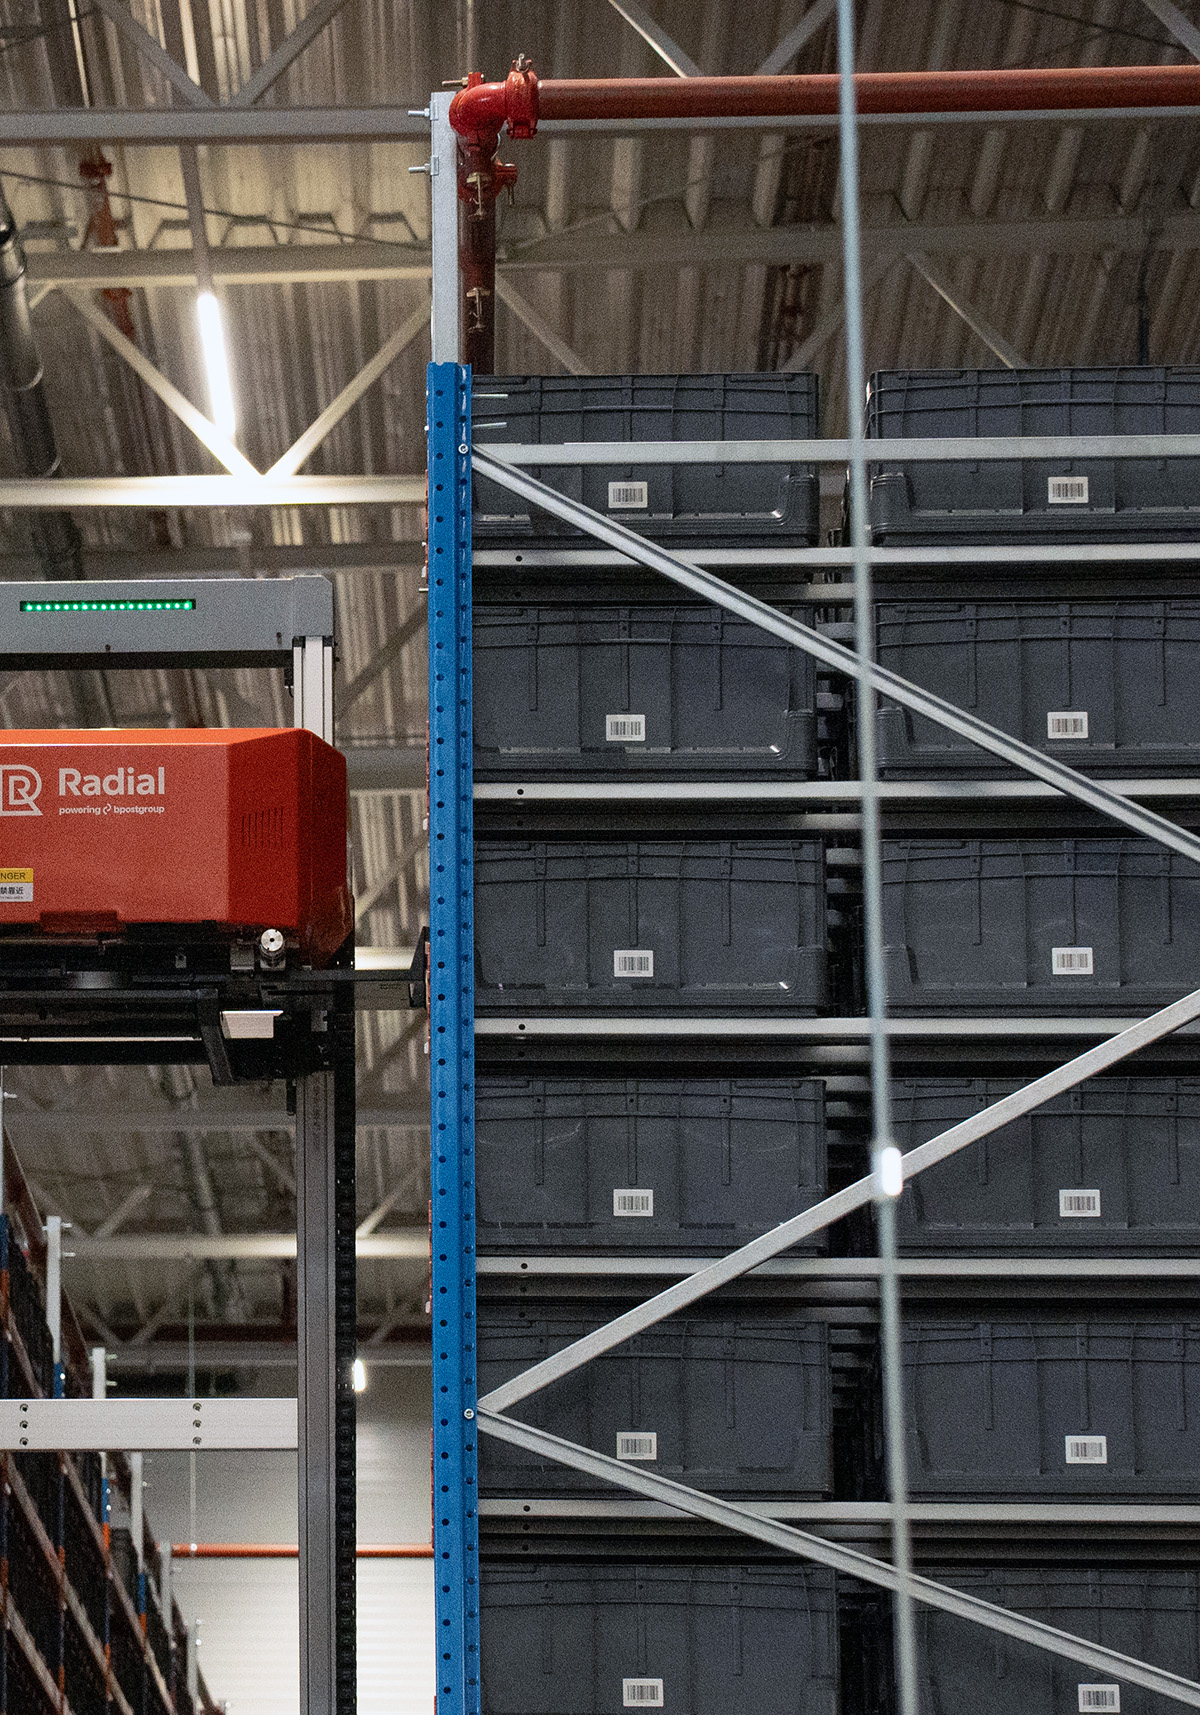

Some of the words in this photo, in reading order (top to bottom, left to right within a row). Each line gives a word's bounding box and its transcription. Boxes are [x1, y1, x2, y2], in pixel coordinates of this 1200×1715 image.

[59, 767, 165, 796] Radial
[59, 805, 100, 815] powering
[113, 805, 165, 815] bpostgroup
